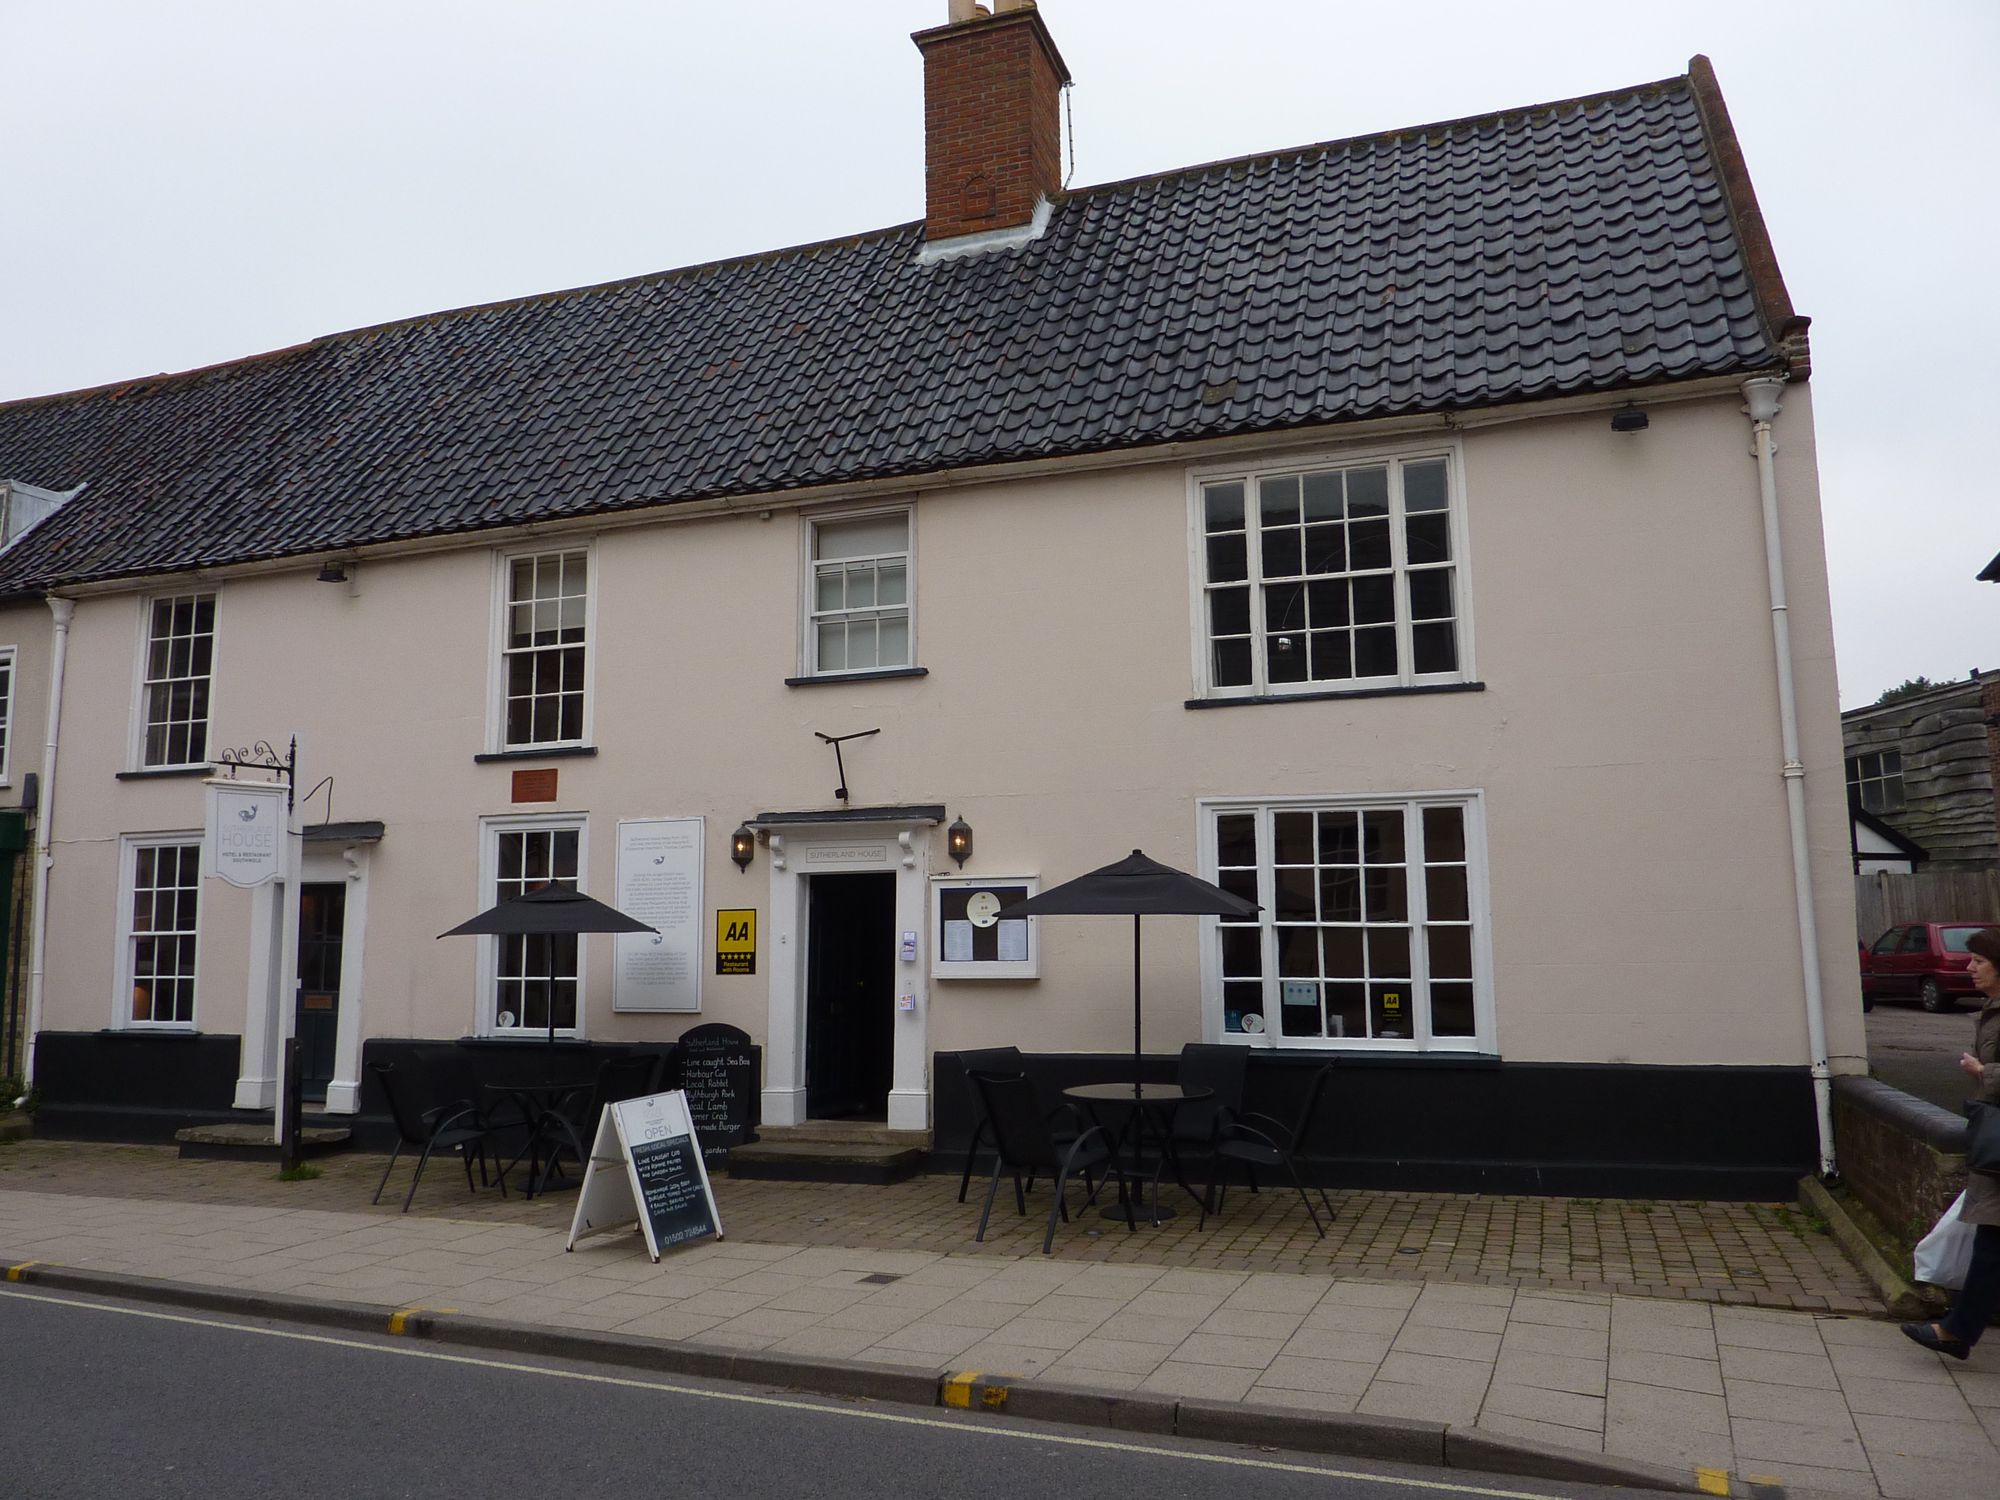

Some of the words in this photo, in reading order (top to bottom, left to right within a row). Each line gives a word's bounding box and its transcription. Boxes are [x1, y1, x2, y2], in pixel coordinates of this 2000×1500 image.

[222, 832, 272, 848] HOUSE
[809, 850, 856, 859] SUTHERLAND
[858, 849, 882, 858] HOUSE
[724, 921, 749, 942] AA
[1386, 996, 1398, 1005] AA
[702, 1057, 725, 1069] caught
[727, 1056, 738, 1066] Sea
[715, 1068, 727, 1077] Cod
[708, 1079, 728, 1088] Rabbit
[721, 1089, 735, 1098] Pork
[689, 1101, 704, 1110] ocal
[708, 1101, 728, 1110] Lamb
[712, 1111, 728, 1120] Crab
[645, 1125, 673, 1139] OPEN
[718, 1121, 741, 1133] Burger
[704, 1146, 728, 1158] garden
[664, 1231, 684, 1245] 01502
